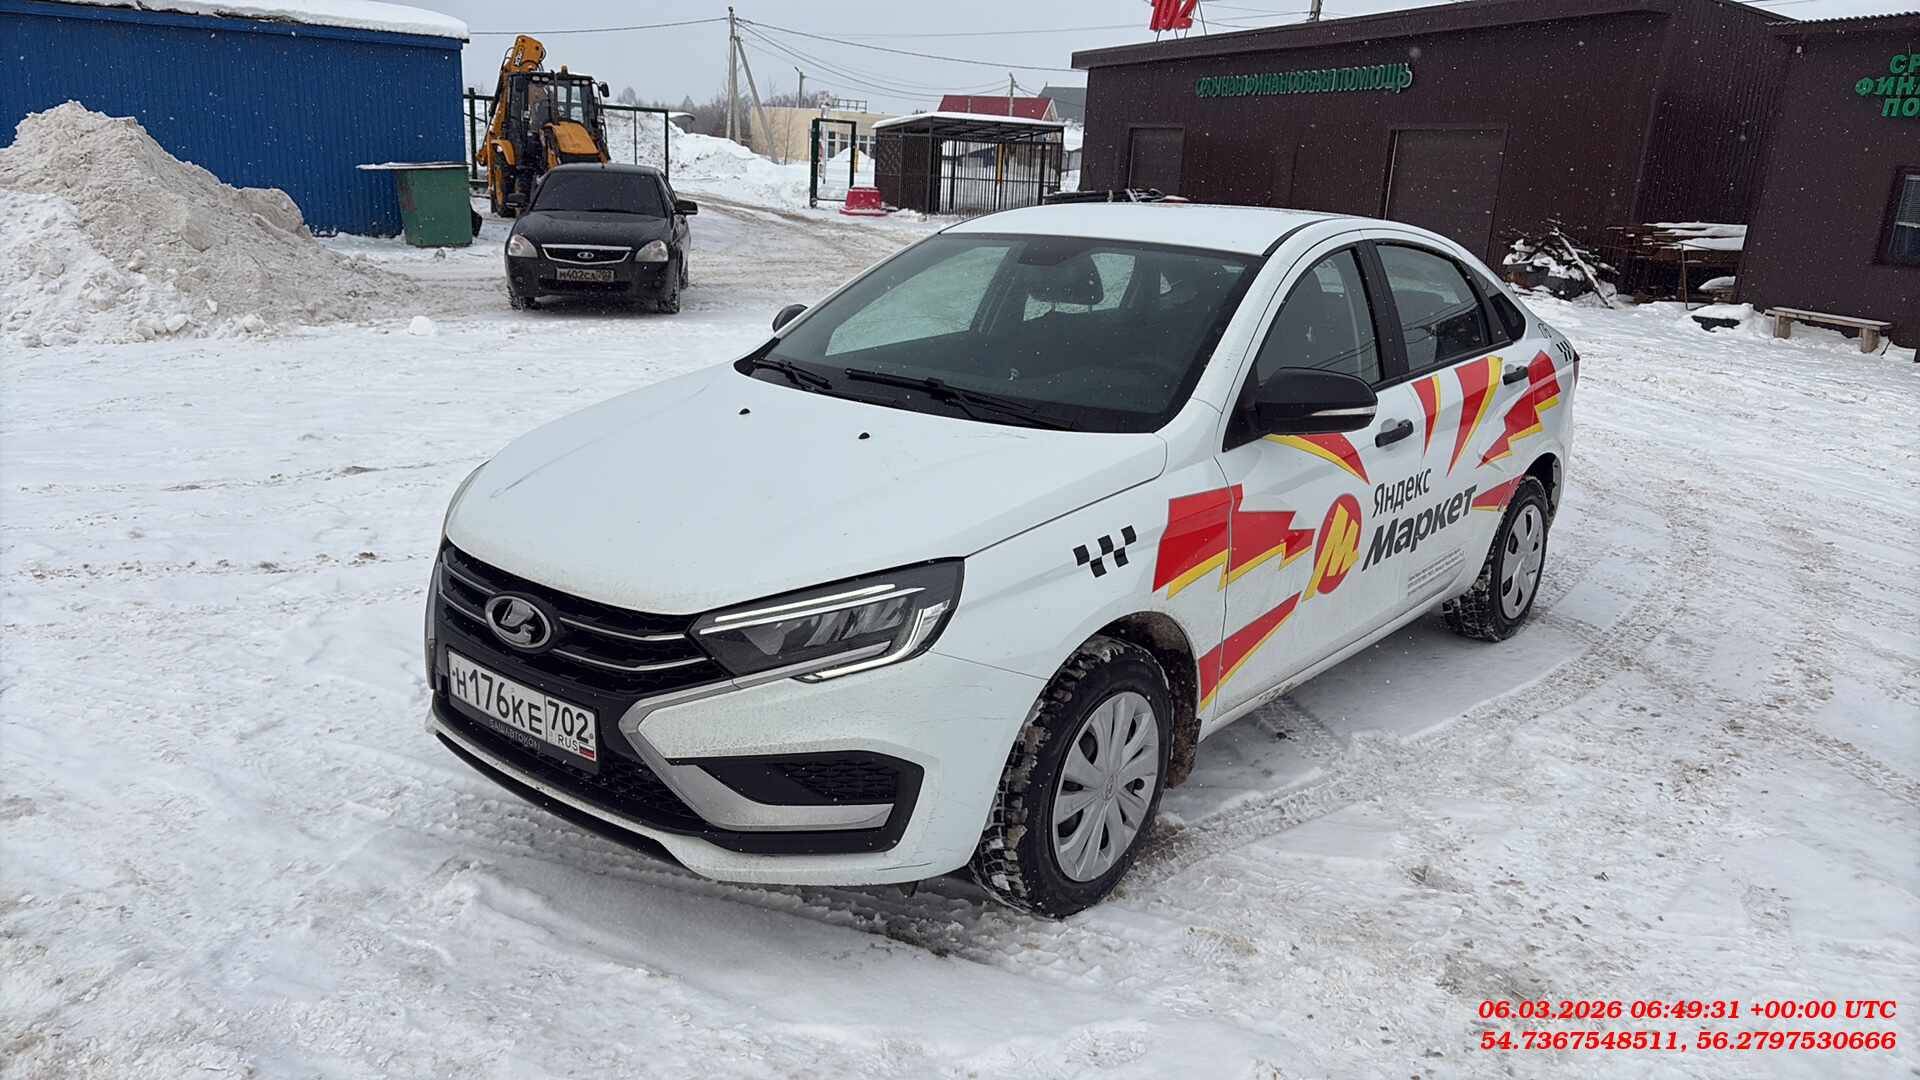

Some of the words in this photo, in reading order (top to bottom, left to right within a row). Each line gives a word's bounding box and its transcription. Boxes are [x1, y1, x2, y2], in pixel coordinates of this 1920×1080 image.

[1336, 62, 1413, 94] ПОМОЩЬ
[1855, 76, 1920, 97] ФИН
[1372, 468, 1432, 518] Яндекс
[1361, 484, 1478, 572] Маркет
[547, 699, 590, 744] 702
[557, 734, 579, 752] RUS
